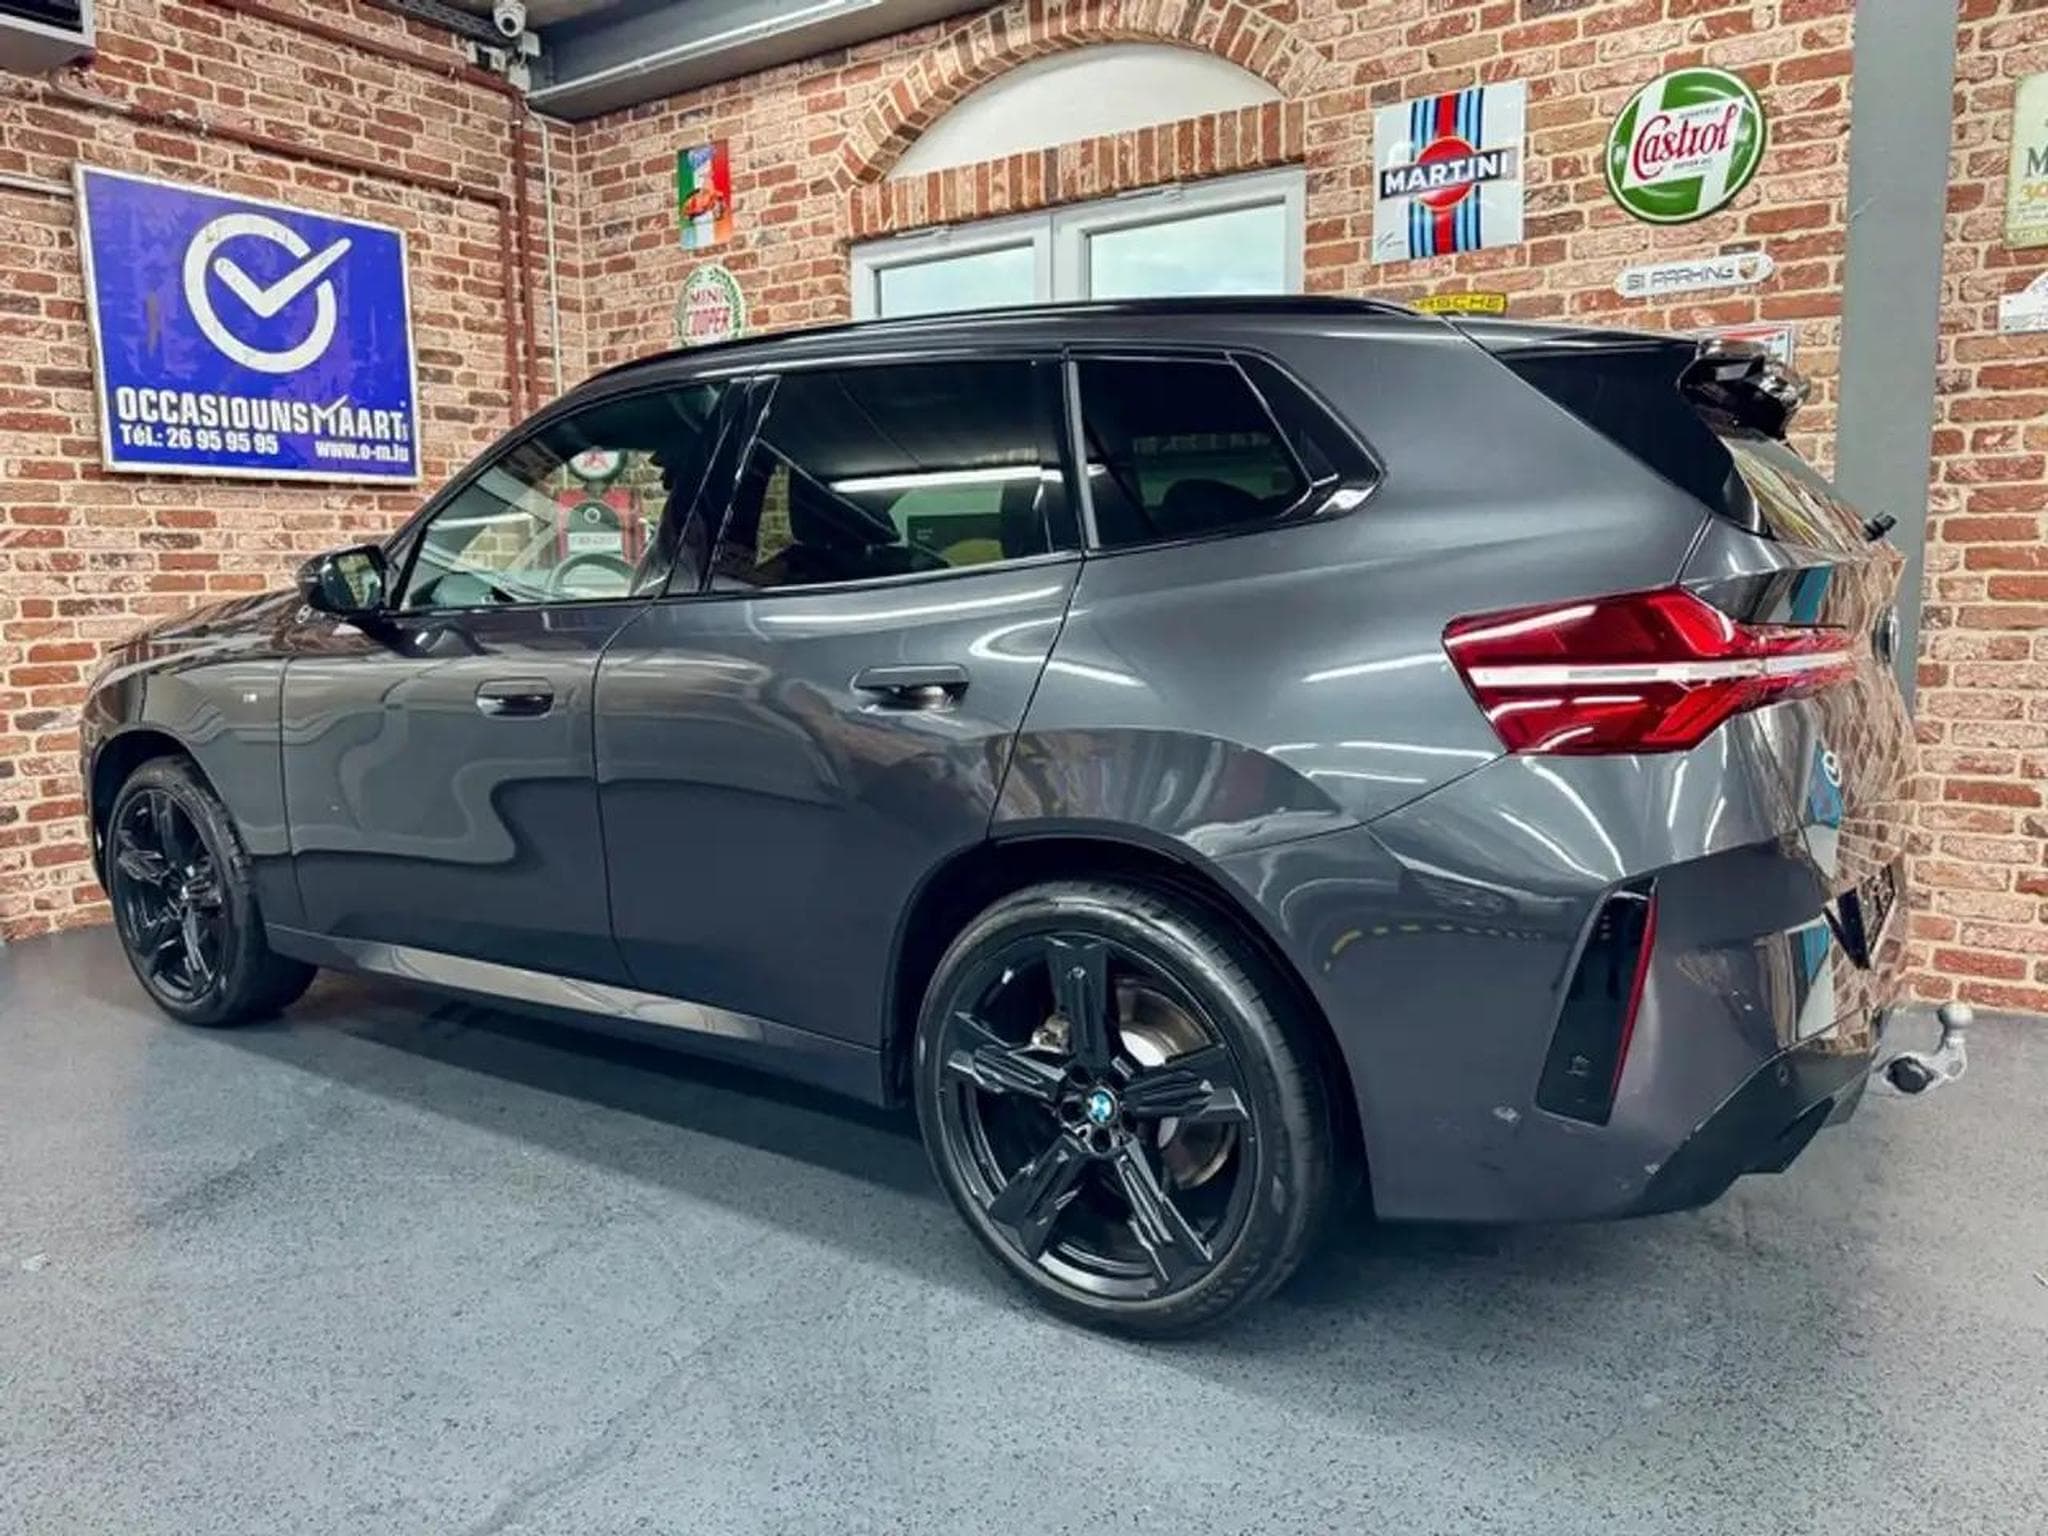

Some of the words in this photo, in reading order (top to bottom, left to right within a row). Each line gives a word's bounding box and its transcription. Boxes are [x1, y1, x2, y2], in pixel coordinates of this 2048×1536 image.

[1633, 103, 1738, 180] Castrol
[1384, 152, 1508, 194] MARTINI
[166, 426, 193, 449] 26
[196, 428, 222, 451] 95
[225, 430, 251, 453] 95
[253, 431, 279, 455] 95
